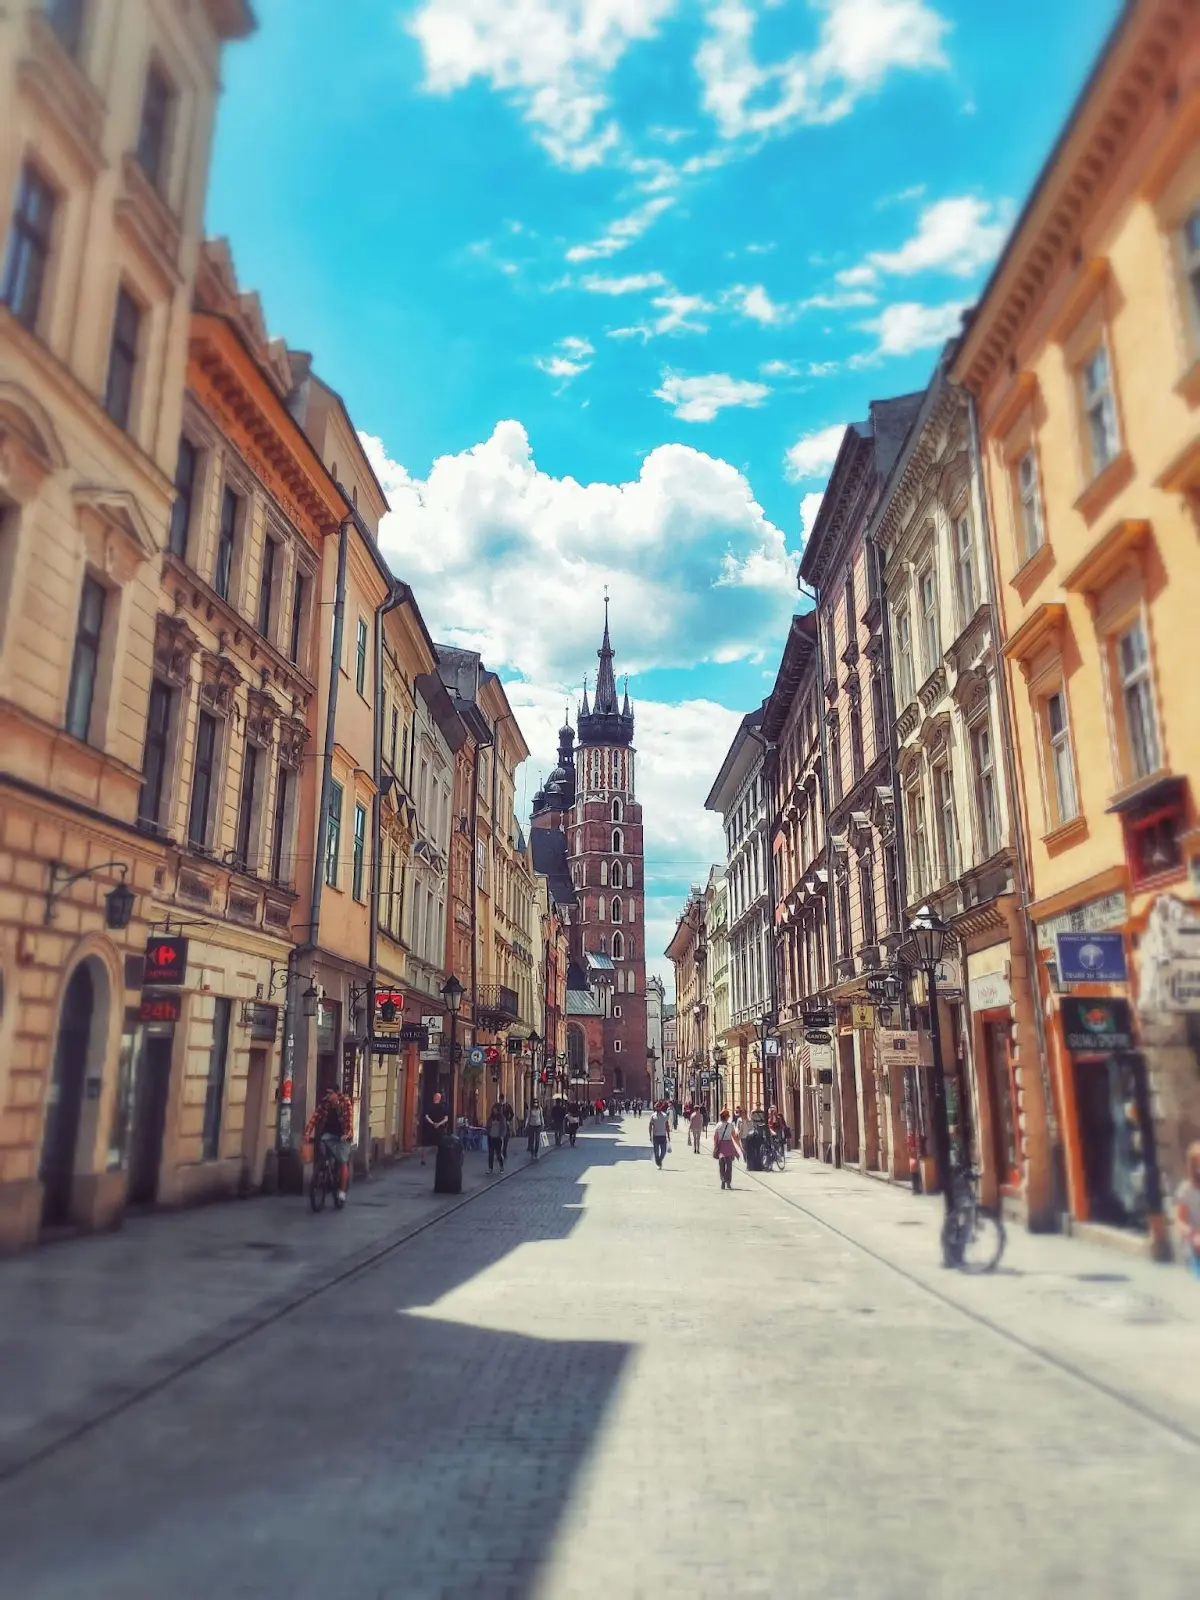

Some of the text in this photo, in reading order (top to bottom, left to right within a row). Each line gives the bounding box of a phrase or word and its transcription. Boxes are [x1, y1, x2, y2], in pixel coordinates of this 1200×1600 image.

[867, 980, 903, 989] INTET
[141, 1001, 176, 1020] 24h
[702, 1078, 708, 1086] P
